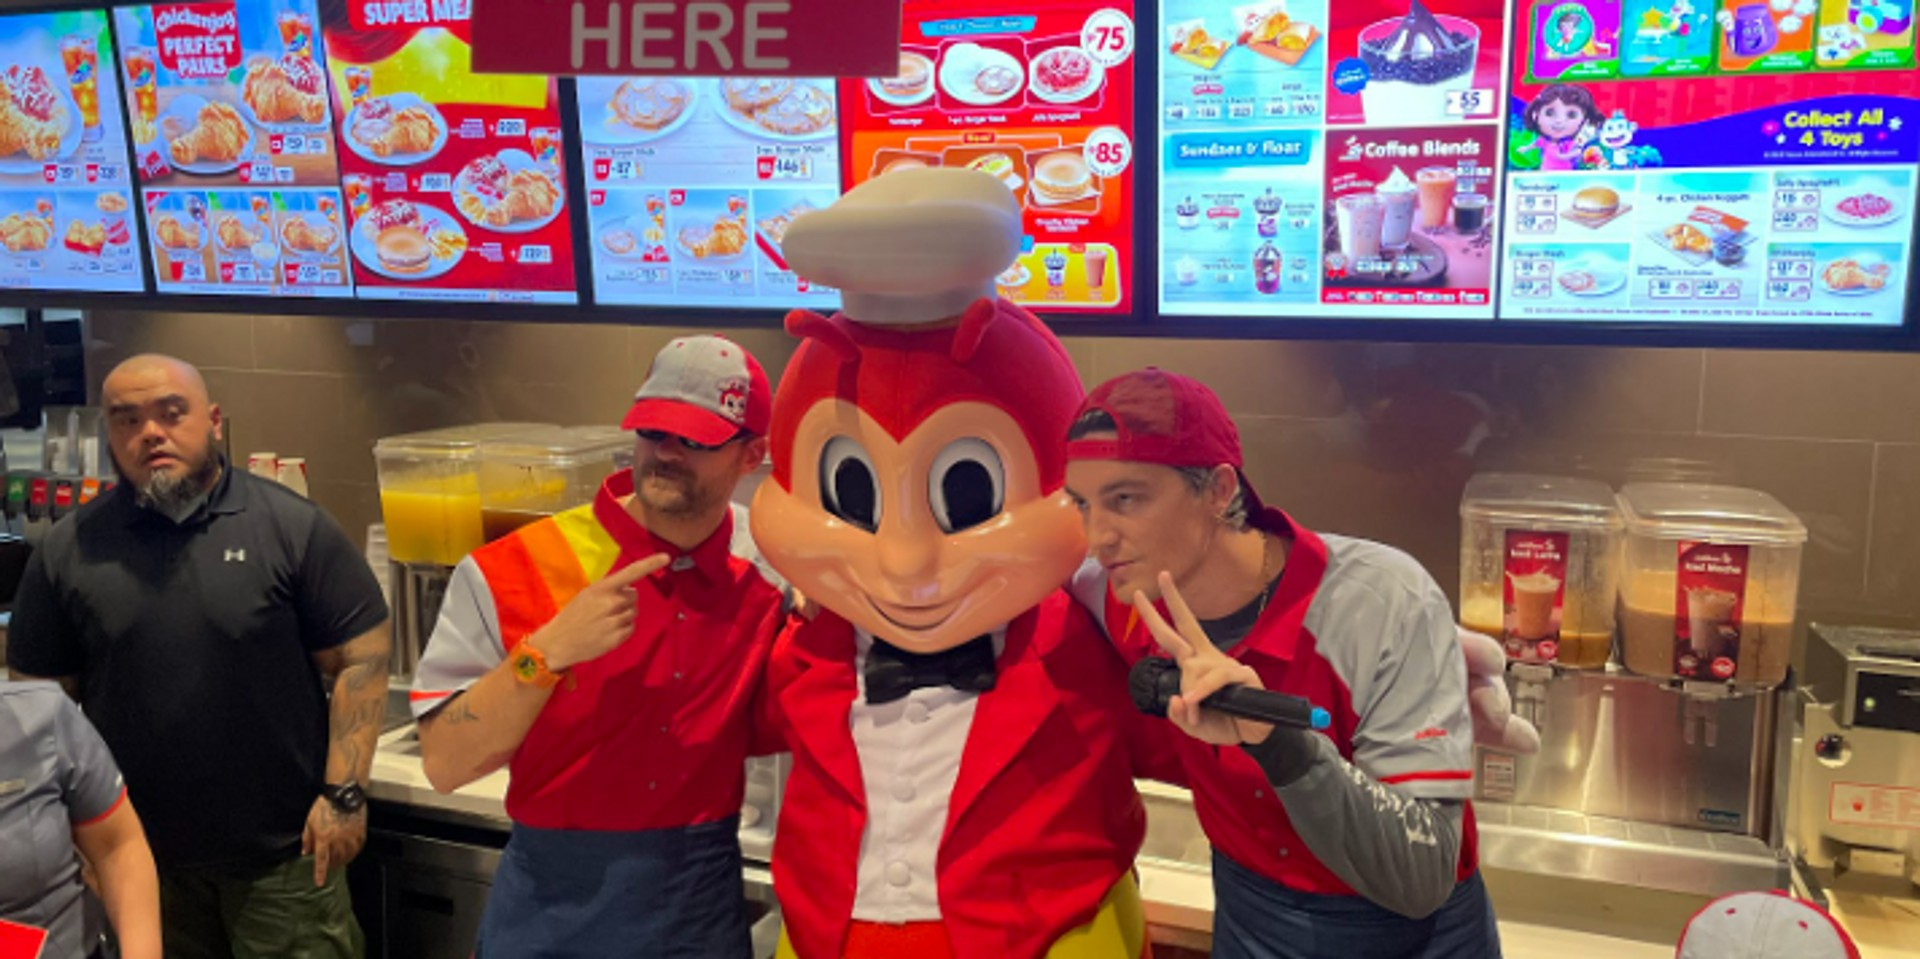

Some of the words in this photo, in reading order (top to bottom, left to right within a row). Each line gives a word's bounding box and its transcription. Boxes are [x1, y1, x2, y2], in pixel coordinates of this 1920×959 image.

[156, 7, 236, 33] Chickenjoy
[364, 2, 429, 24] SUPER
[163, 35, 235, 57] PERFECT
[571, 2, 791, 70] HERE
[177, 56, 226, 77] PAIRS
[1459, 91, 1480, 108] 55
[1784, 108, 1852, 128] Collect
[1858, 108, 1884, 126] All
[1180, 142, 1242, 158] Sundaes
[1262, 140, 1302, 155] Float
[1365, 141, 1419, 158] Coffee
[1423, 138, 1480, 157] Blends
[1799, 130, 1815, 147] 4
[1820, 130, 1863, 149] Toys
